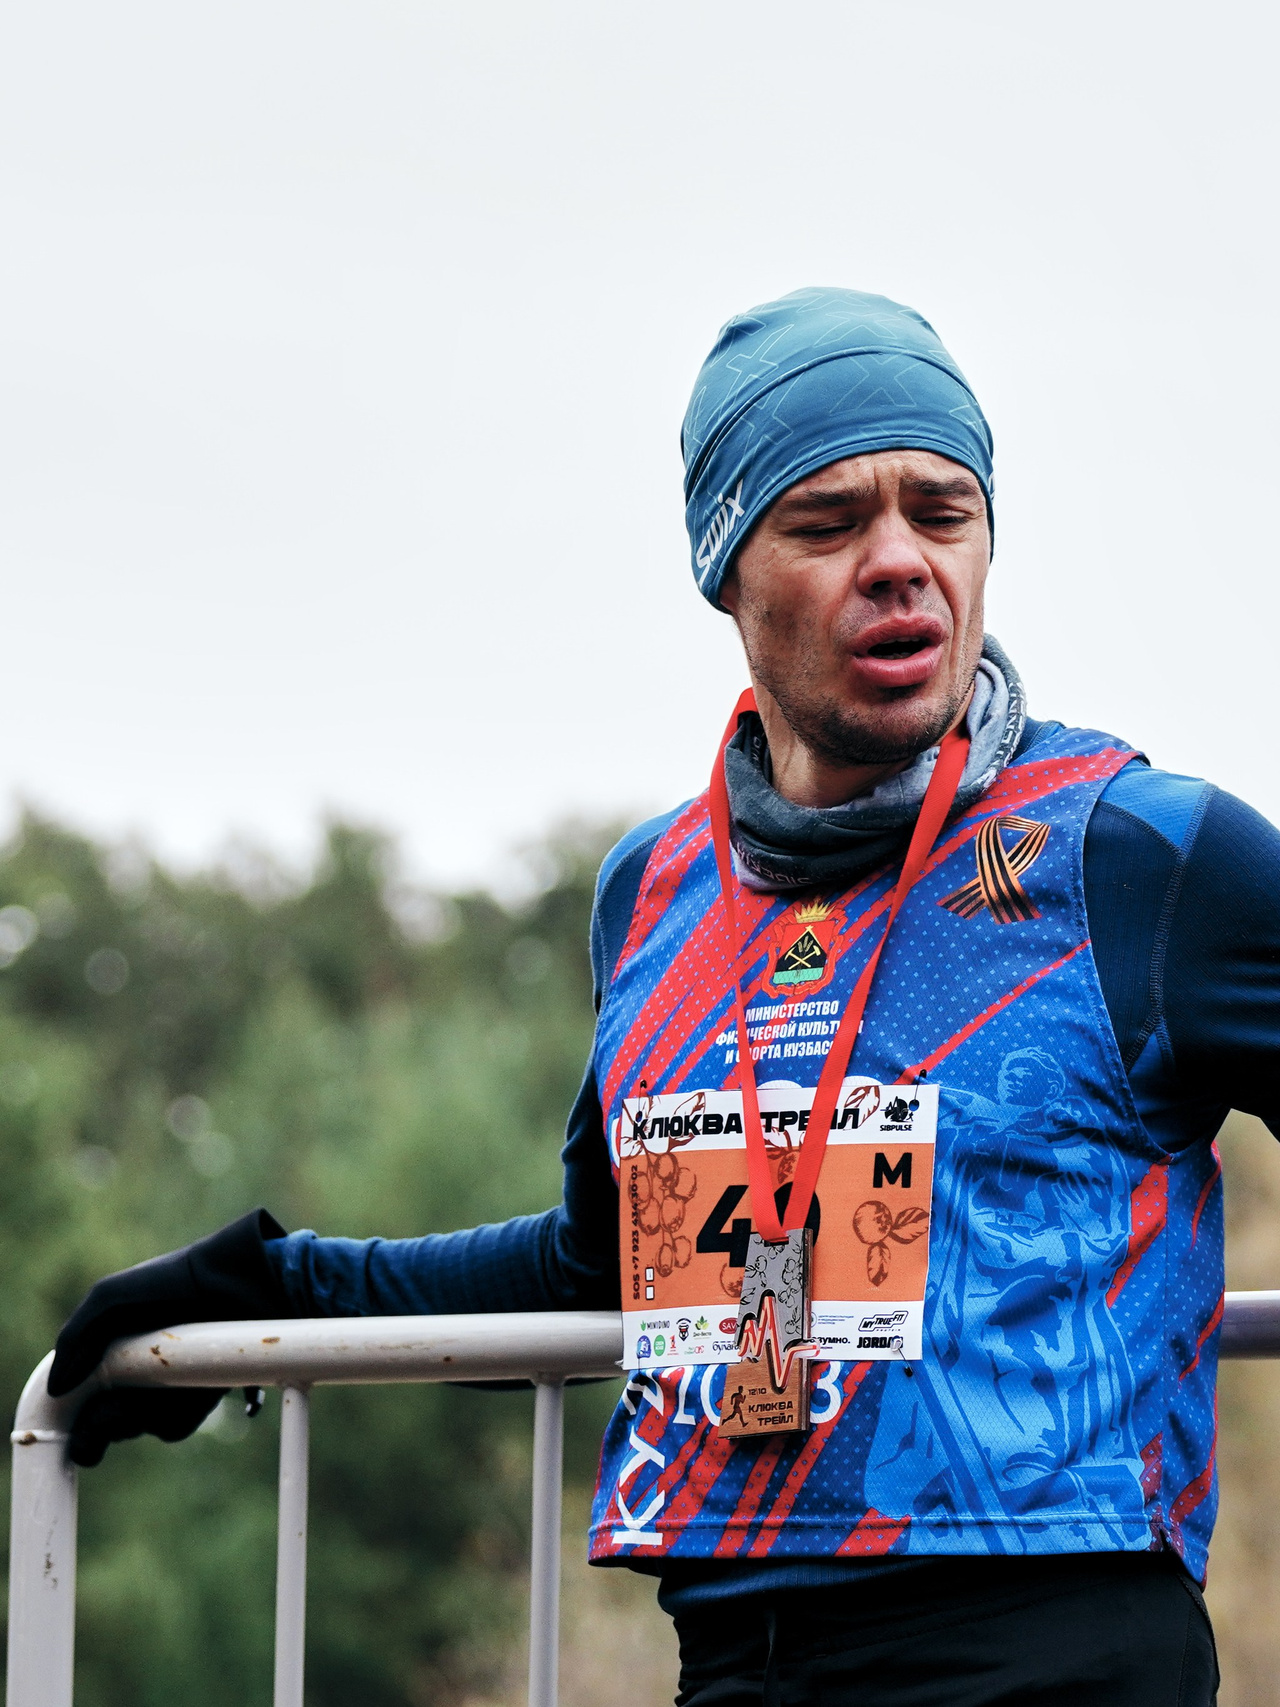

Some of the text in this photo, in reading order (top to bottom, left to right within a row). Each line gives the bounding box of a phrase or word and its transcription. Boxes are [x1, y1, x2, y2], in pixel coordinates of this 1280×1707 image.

[745, 1000, 839, 1022] МИНИСТЕРСТВО
[725, 1049, 735, 1064] И
[632, 1113, 743, 1140] КЛЮКВА
[879, 1124, 913, 1132] SIBPULSE
[632, 1273, 640, 1300] SOS
[856, 1336, 904, 1349] JORD
[748, 1401, 794, 1413] КЛЮКВА
[757, 1412, 794, 1427] ТРЕЙЛ
